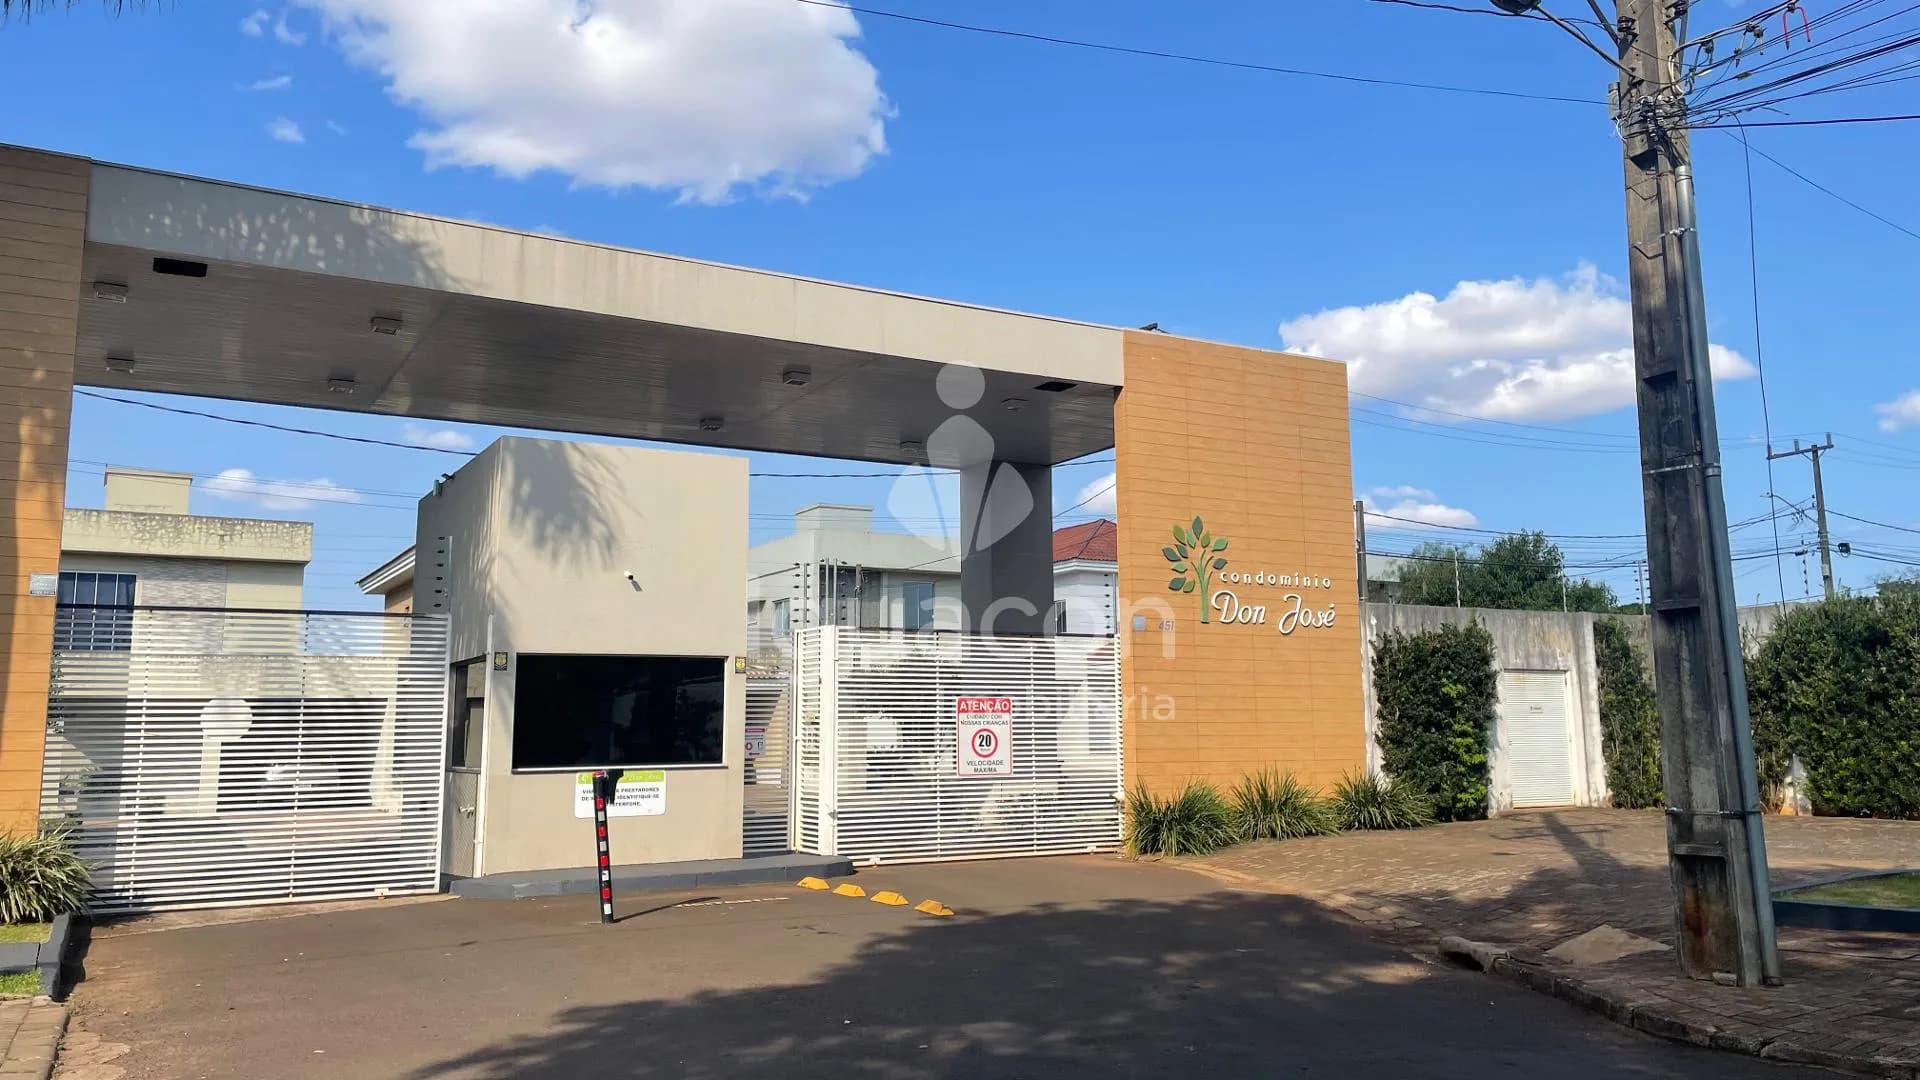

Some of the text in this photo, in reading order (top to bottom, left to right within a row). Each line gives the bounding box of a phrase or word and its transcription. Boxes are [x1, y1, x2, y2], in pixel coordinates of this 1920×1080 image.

[1219, 570, 1332, 589] condomínio
[1211, 590, 1337, 635] Don José
[960, 700, 1010, 712] ATENÇÃO
[979, 734, 992, 748] 20
